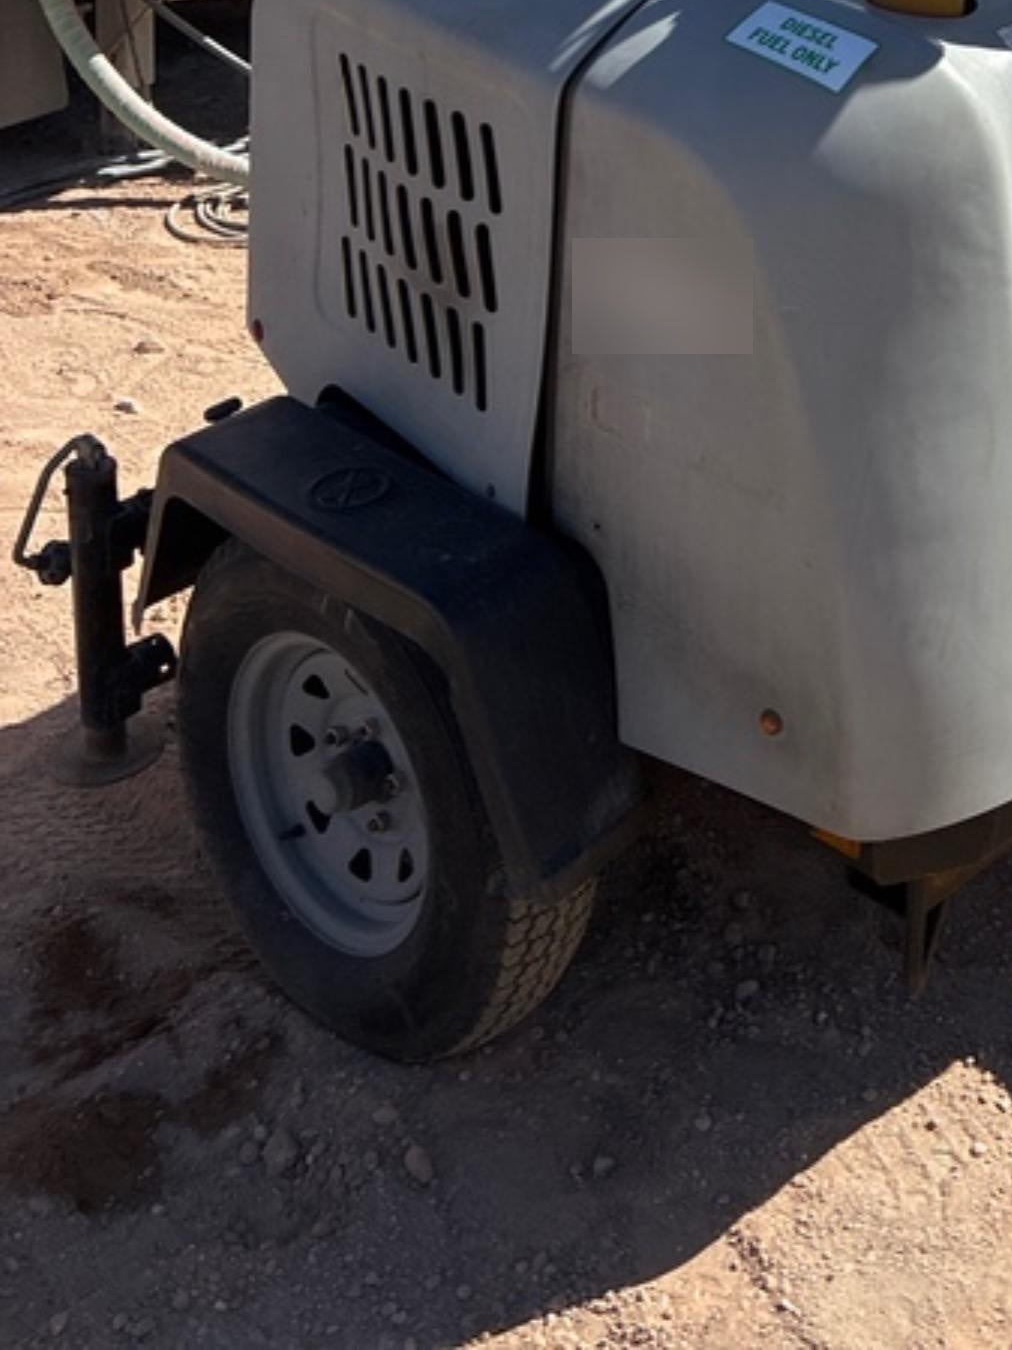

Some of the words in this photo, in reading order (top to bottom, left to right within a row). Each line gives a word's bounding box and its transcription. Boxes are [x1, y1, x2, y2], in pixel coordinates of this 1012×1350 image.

[748, 26, 792, 56] FUEL
[790, 44, 841, 76] ONLY
[780, 17, 840, 51] DIESEL
